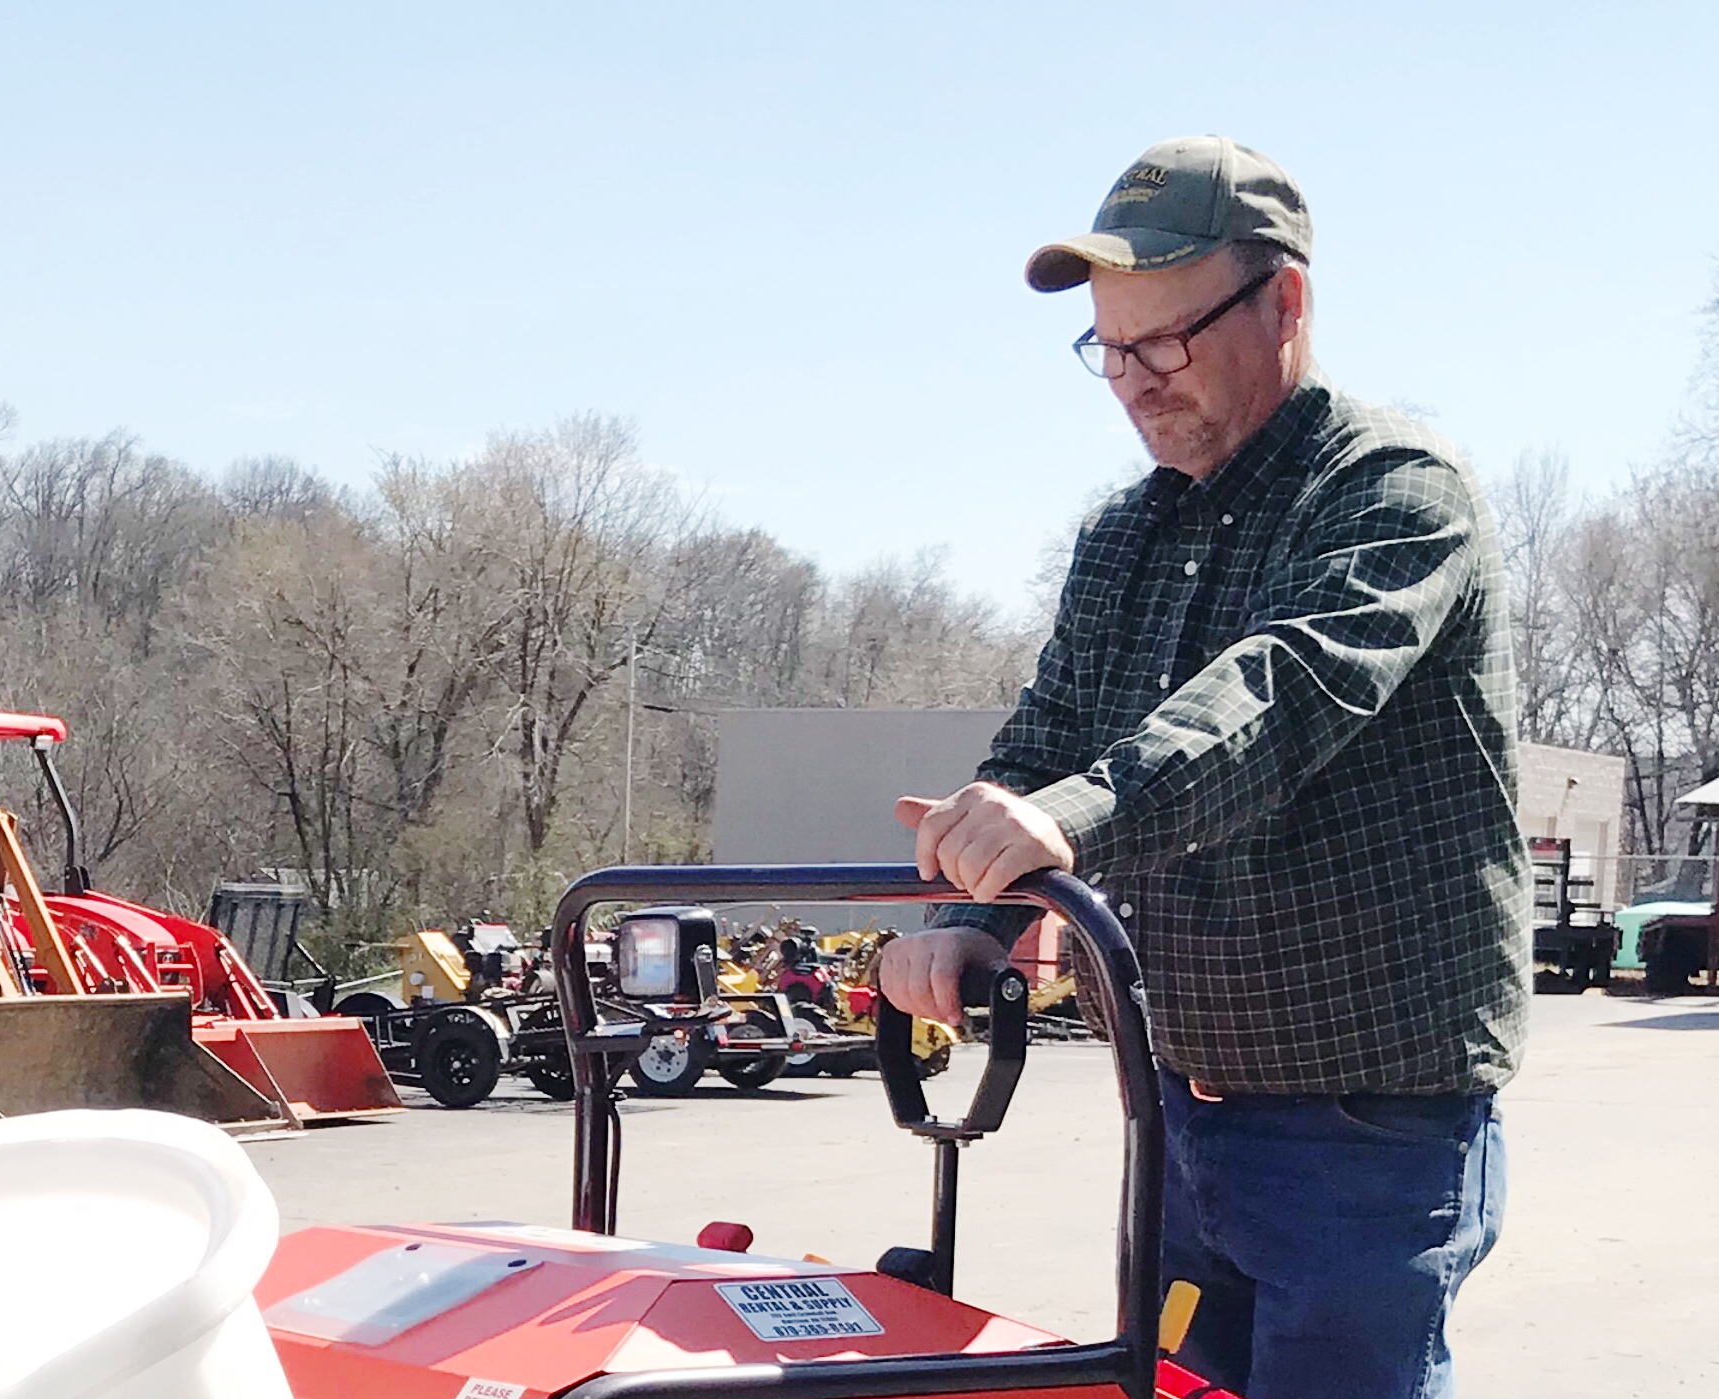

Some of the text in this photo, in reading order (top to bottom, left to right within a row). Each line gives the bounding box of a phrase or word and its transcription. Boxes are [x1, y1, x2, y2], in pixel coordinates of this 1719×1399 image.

[740, 1282, 830, 1301] CENTRAL
[738, 1301, 790, 1314] RENTAL
[789, 1300, 803, 1311] &
[803, 1297, 853, 1311] SUPPLY
[471, 1383, 514, 1399] PLEASE
